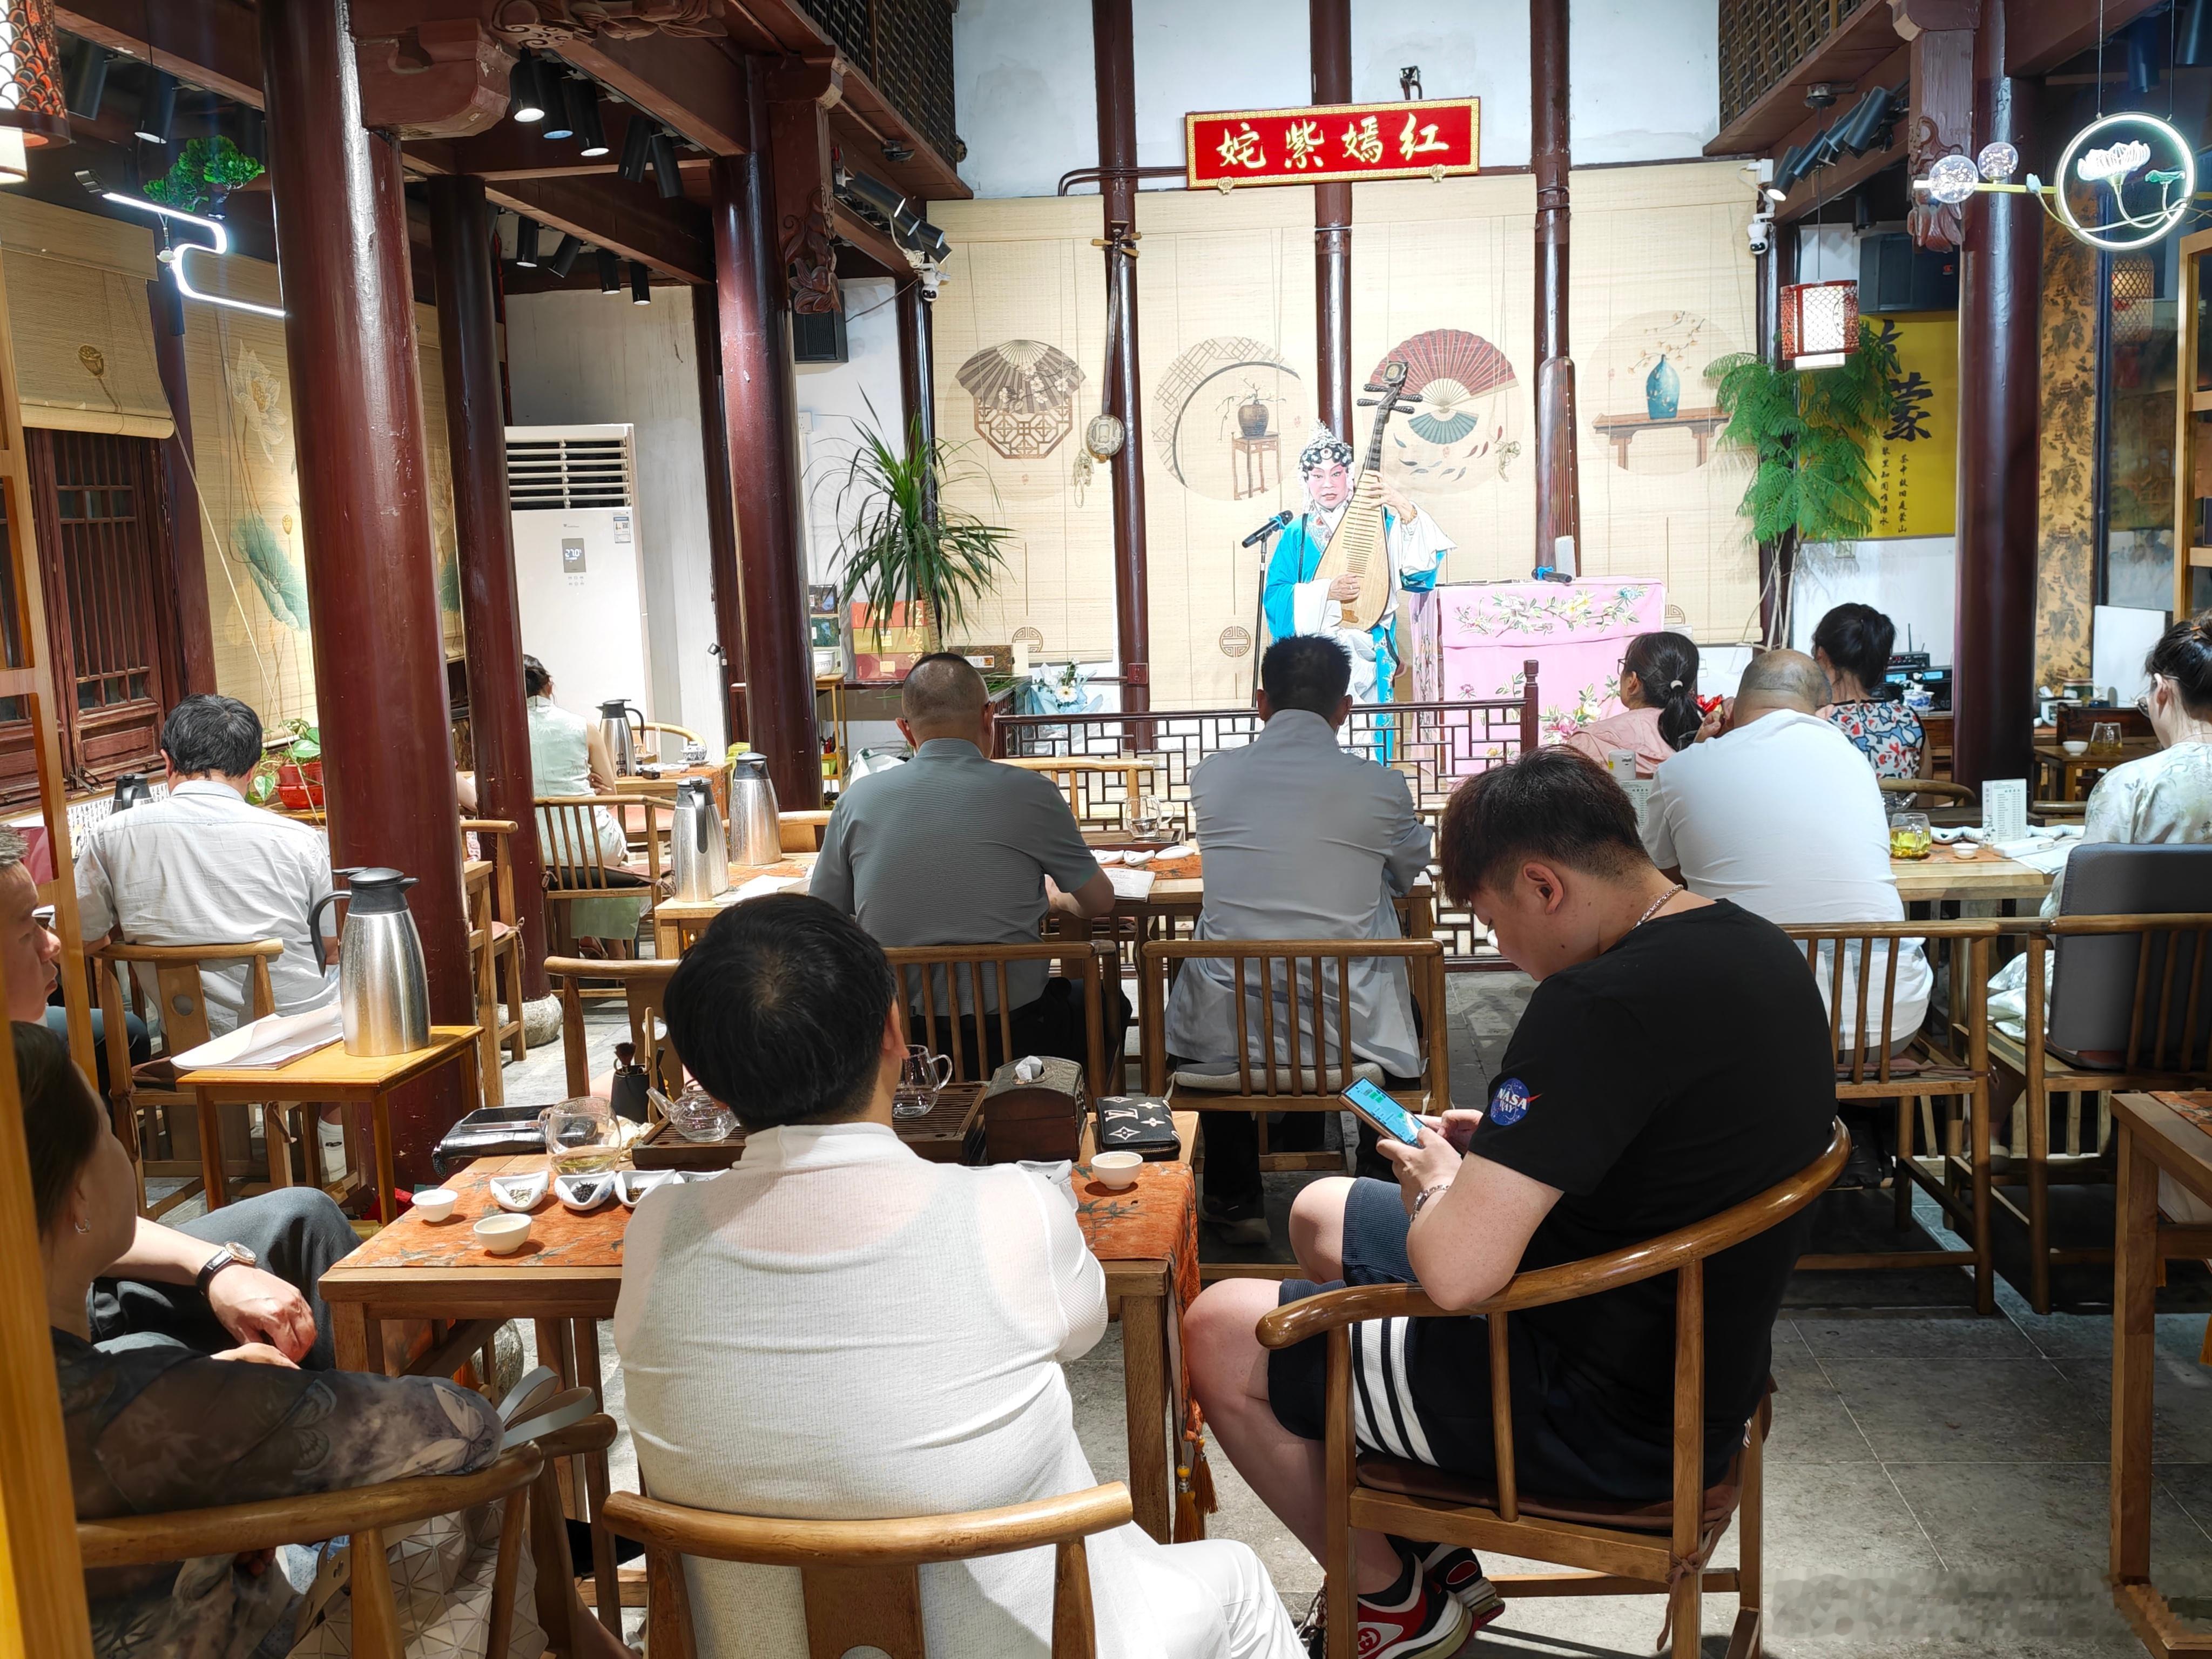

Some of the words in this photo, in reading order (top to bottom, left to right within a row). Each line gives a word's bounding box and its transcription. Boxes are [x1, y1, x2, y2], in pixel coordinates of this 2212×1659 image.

[1216, 112, 1449, 169] 姹紫嫣红
[1497, 1088, 1527, 1110] NASA
